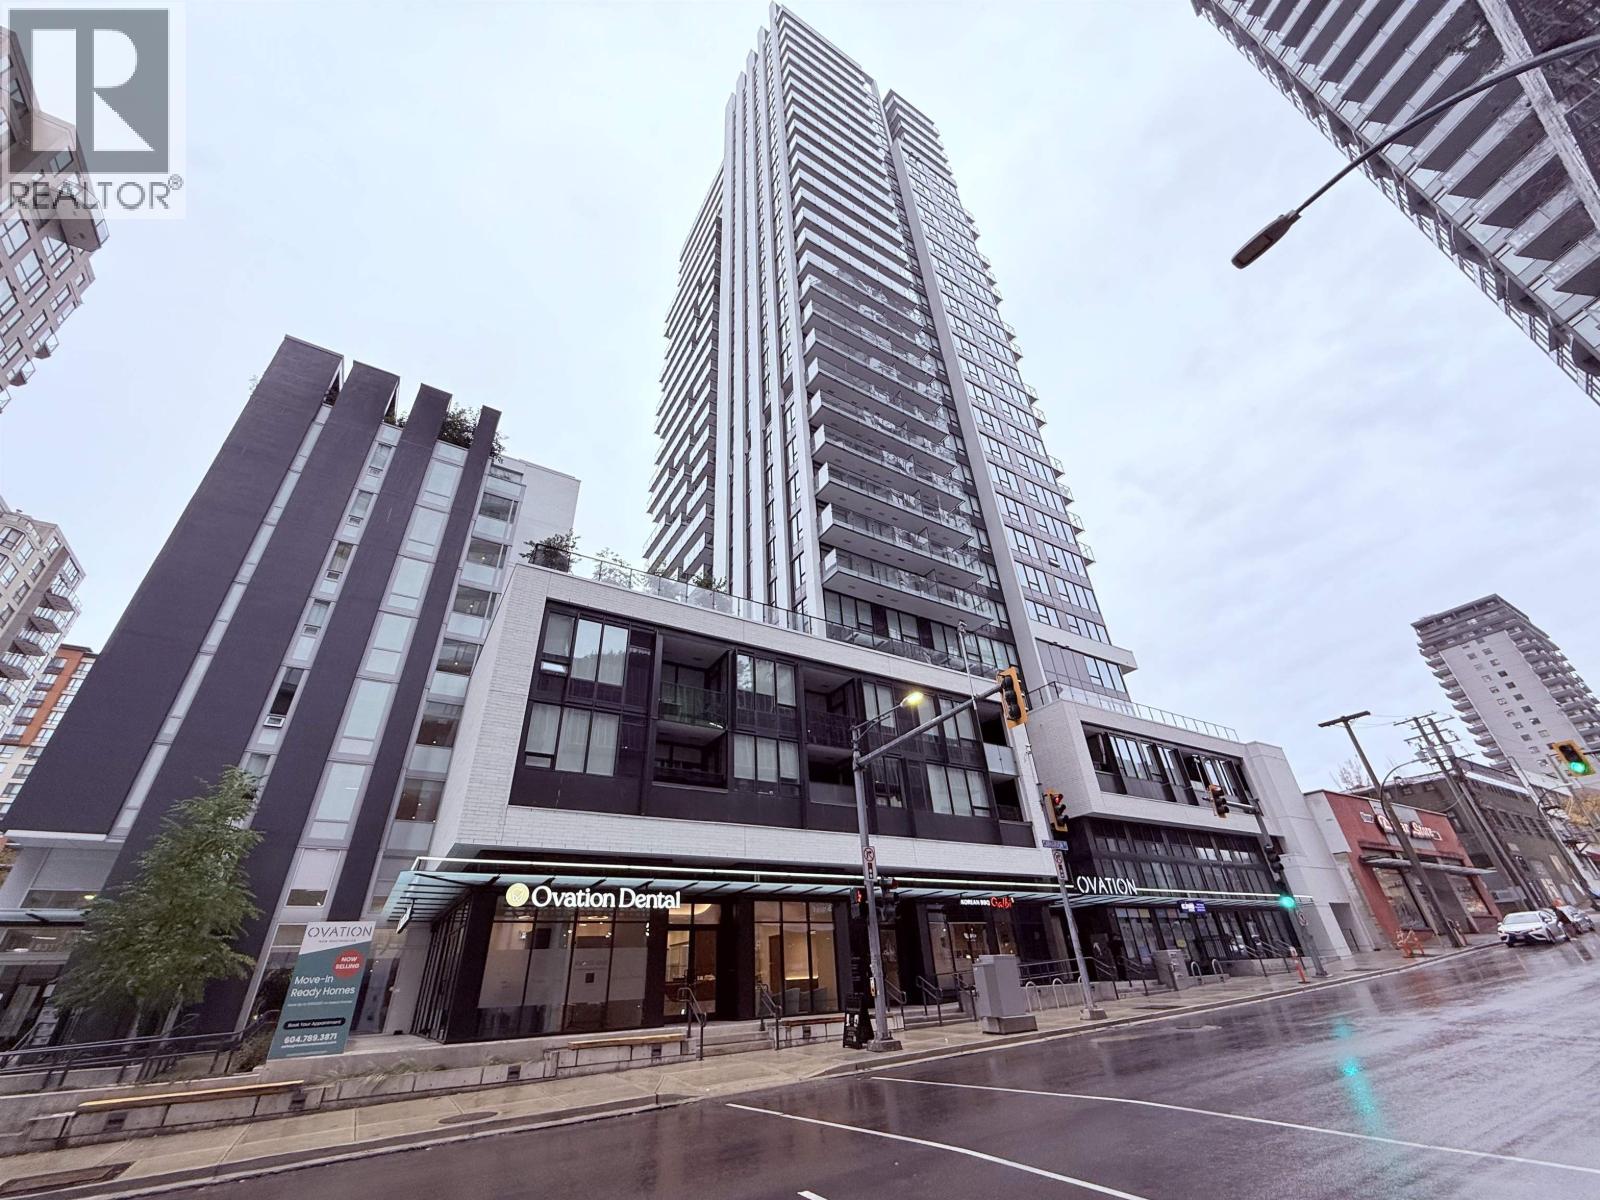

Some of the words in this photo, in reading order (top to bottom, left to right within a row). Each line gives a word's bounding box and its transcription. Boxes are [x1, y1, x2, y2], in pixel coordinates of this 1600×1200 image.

[1076, 875, 1138, 895] OVATION
[531, 885, 616, 907] Ovation
[618, 887, 681, 909] Dental
[307, 926, 373, 938] OVATION
[290, 986, 322, 999] Ready
[322, 986, 356, 996] Homes
